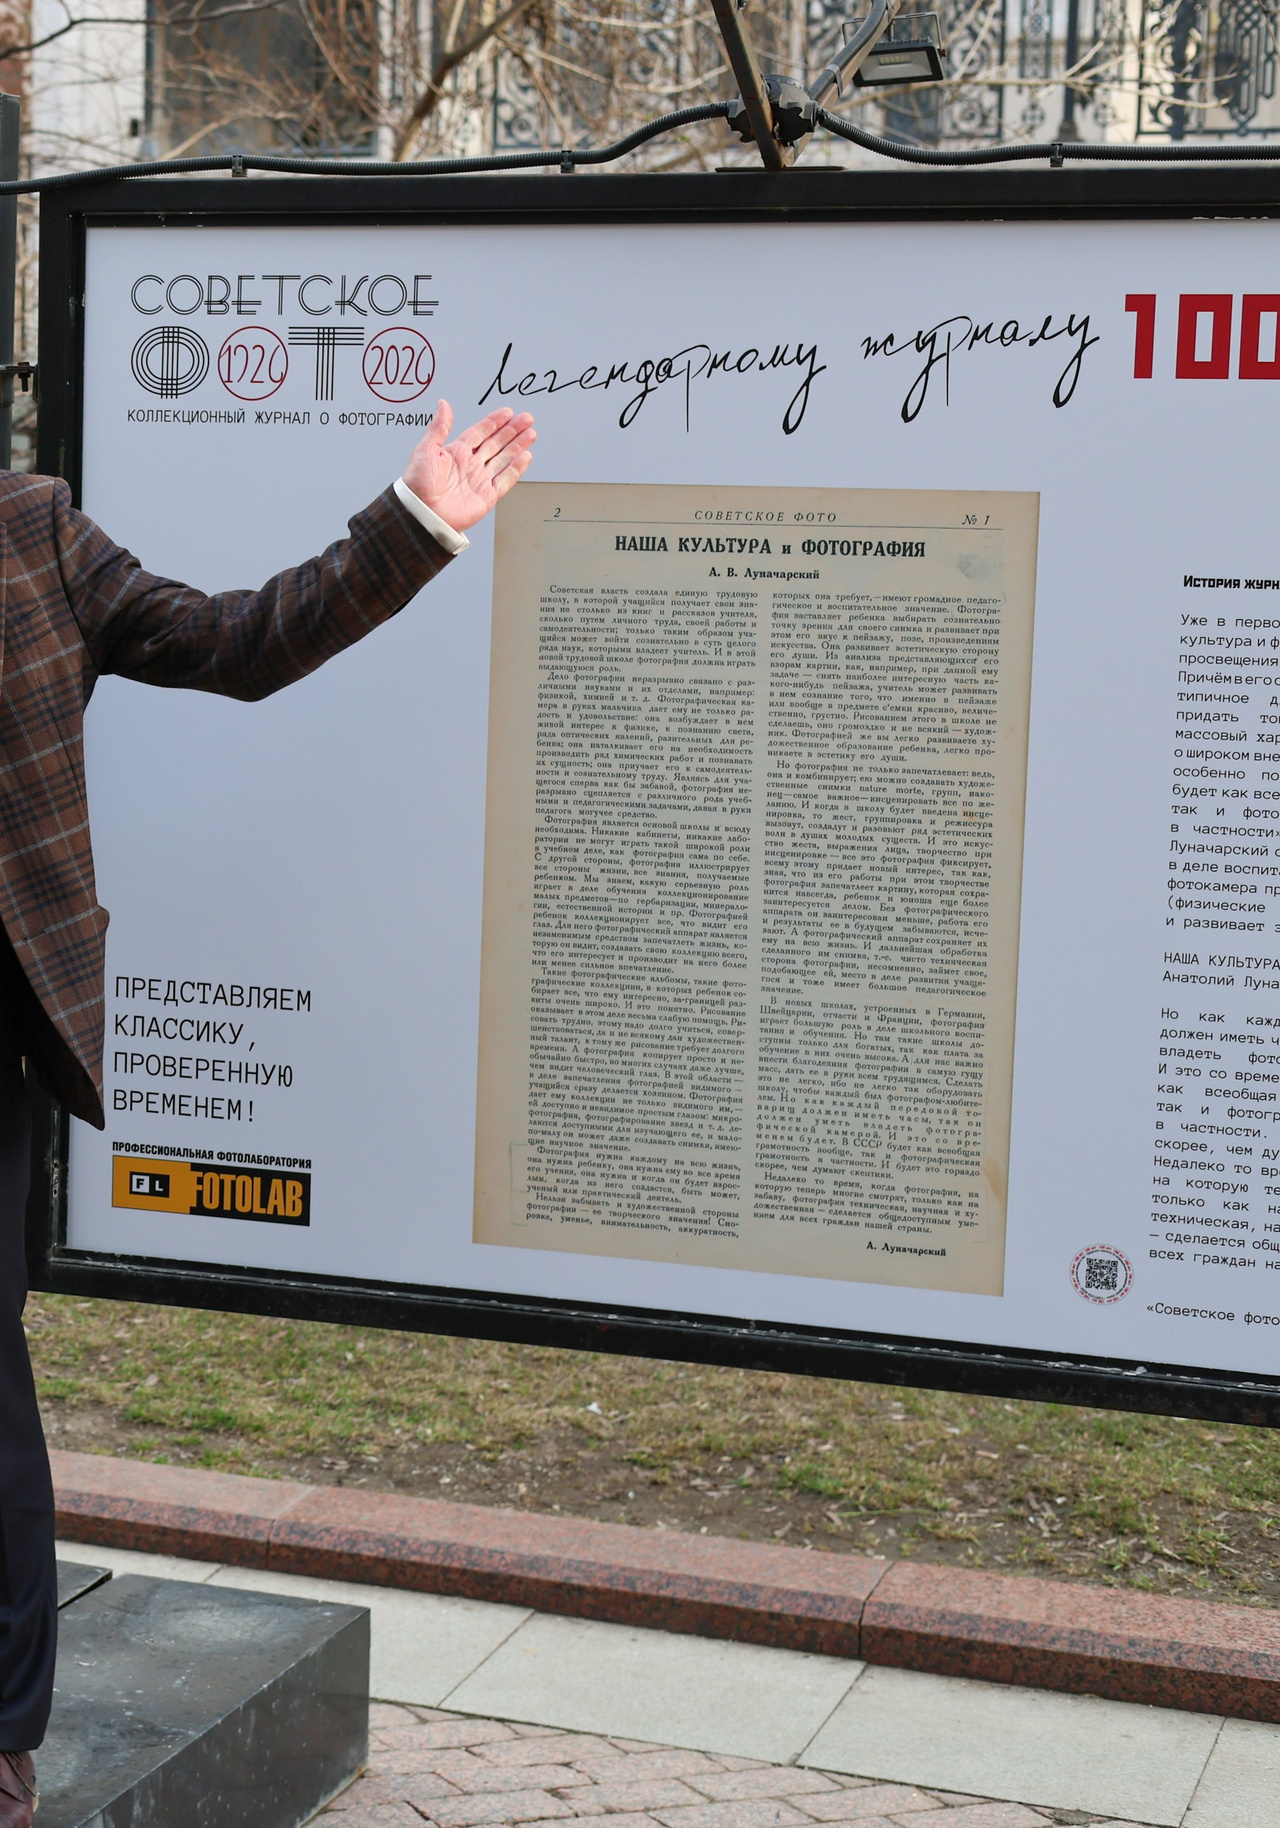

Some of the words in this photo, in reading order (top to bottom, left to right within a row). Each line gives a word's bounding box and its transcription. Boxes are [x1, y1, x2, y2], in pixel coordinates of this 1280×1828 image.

[131, 274, 439, 316] СОВЕТСКОЕ
[478, 342, 827, 435] Легендарному
[860, 312, 1101, 424] журналу
[1124, 293, 1280, 380] 100
[128, 408, 245, 425] КОЛЛЕКЦИОННЫЙ
[254, 411, 310, 425] ЖУРНАЛ
[319, 412, 329, 425] О
[338, 412, 433, 426] ФОТОГРАФИИ
[553, 507, 561, 518] 2
[694, 510, 785, 522] СОВЕТСКОЕ
[793, 512, 837, 524] ФОТО
[615, 535, 669, 552] НАША
[678, 537, 772, 554] КУЛЬТУРА
[781, 544, 791, 554] и
[801, 539, 926, 557] ФОТОГРАФИЯ
[709, 566, 721, 577] А.
[727, 567, 738, 577] В.
[744, 567, 820, 581] Луначарский
[549, 585, 594, 594] Советская
[675, 590, 708, 599] единую
[716, 592, 758, 600] трудовую
[848, 613, 885, 623] ребенка
[893, 614, 936, 624] выбирать
[1181, 614, 1208, 626] Уже
[1217, 618, 1226, 627] в
[1180, 636, 1252, 649] культура
[1257, 638, 1266, 647] и
[1179, 654, 1279, 668] просвещения
[1178, 671, 1232, 685] Причём
[1177, 692, 1249, 704] типичное
[1176, 711, 1239, 723] придать
[1175, 730, 1247, 742] массовый
[1186, 749, 1250, 762] широком
[1173, 766, 1246, 780] особенно
[1172, 783, 1217, 799] будет
[1222, 789, 1248, 799] как
[1169, 840, 1268, 857] Луначарский
[1167, 877, 1257, 896] фотокамера
[1168, 895, 1266, 913] (физические
[1184, 918, 1265, 932] развивает
[1164, 952, 1200, 965] НАША
[1208, 955, 1280, 970] КУЛЬТУРА
[1162, 970, 1234, 986] Анатолий
[116, 976, 311, 1012] ПРЕДСТАВЛЯЕМ
[115, 1014, 255, 1052] КЛАССИКУ,
[114, 1051, 293, 1087] ПРОВЕРЕННУЮ
[113, 1089, 253, 1122] ВРЕМЕНЕМ!
[1180, 1123, 1267, 1138] частности.
[112, 1141, 214, 1160] ПРОФЕССИОНАЛЬНАЯ
[216, 1151, 312, 1169] ФОТОЛАБОРАТОРИЯ
[1154, 1139, 1214, 1155] скорее,
[1226, 1145, 1253, 1156] чем
[1154, 1155, 1225, 1172] Недалеко
[1234, 1164, 1252, 1174] то
[190, 1170, 304, 1218] FOTOLAB
[1186, 1179, 1249, 1195] которую
[1151, 1213, 1255, 1233] техническая,
[1165, 1232, 1245, 1248] сделается
[866, 1241, 877, 1250] А.
[881, 1242, 946, 1256] Луначарский
[1193, 1253, 1256, 1268] граждан
[1147, 1302, 1235, 1321] «Советское
